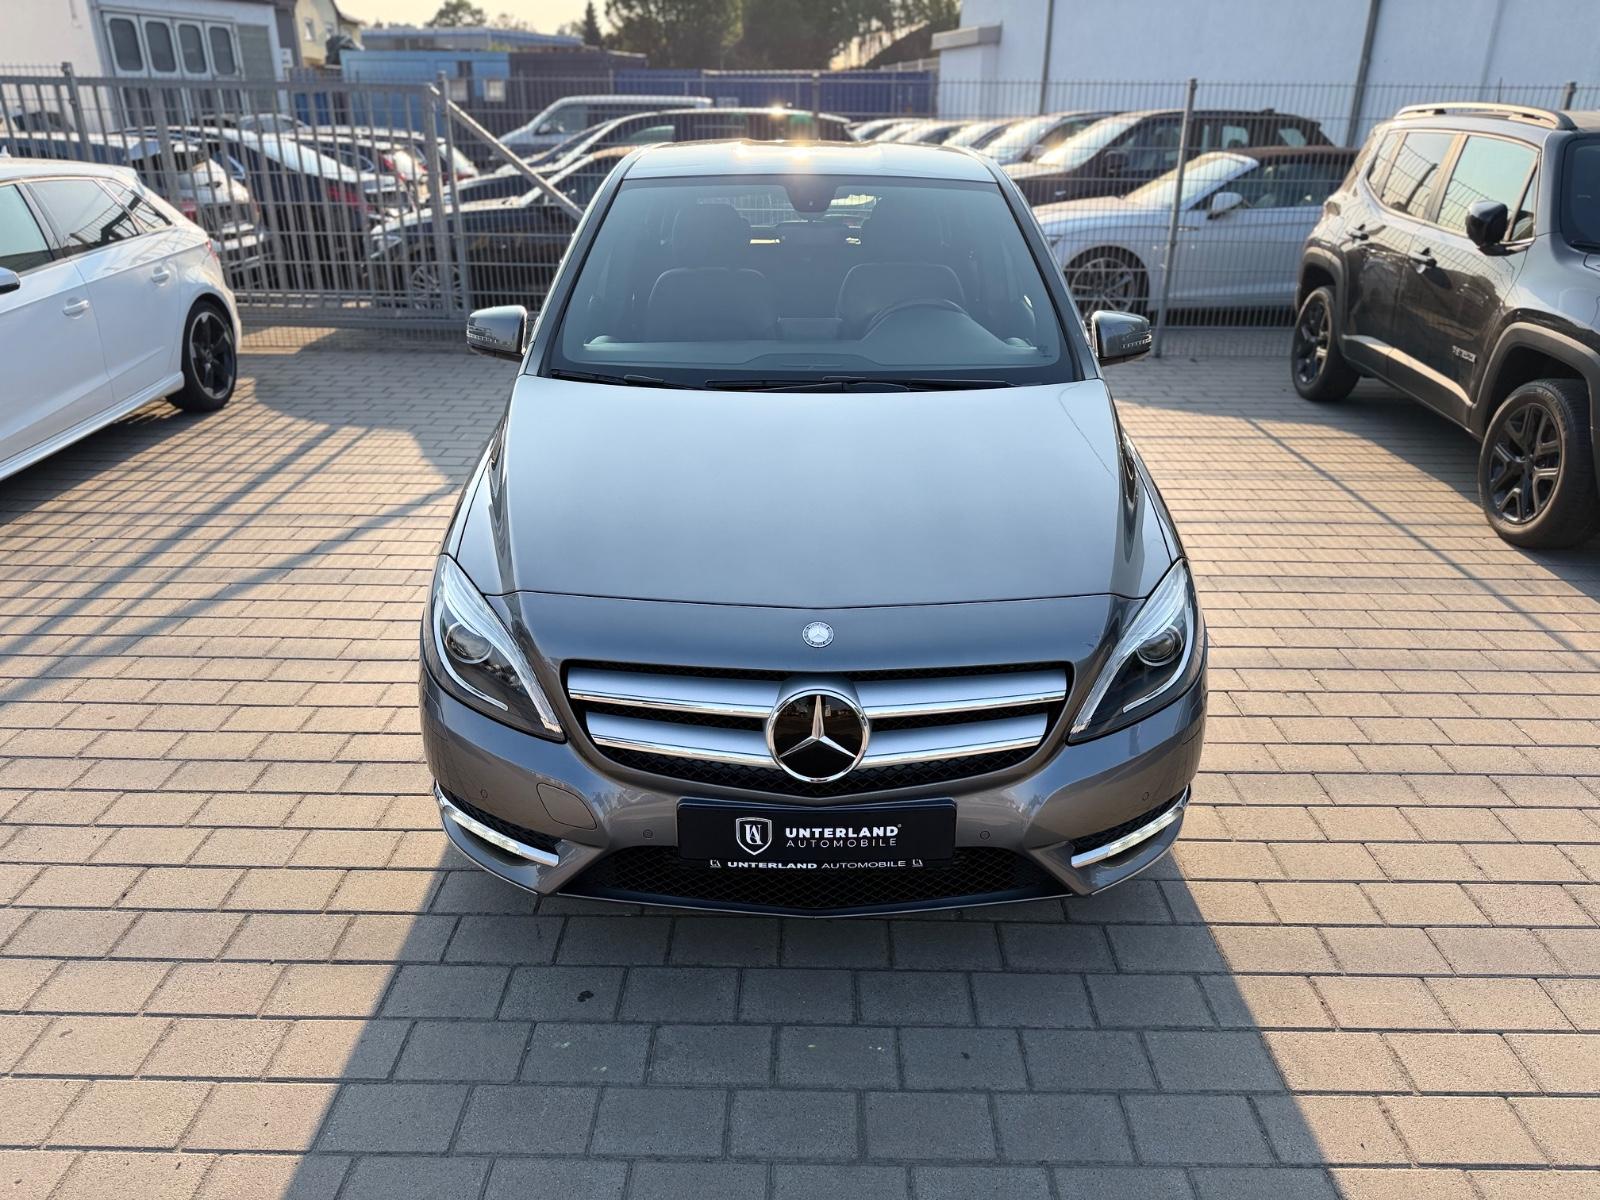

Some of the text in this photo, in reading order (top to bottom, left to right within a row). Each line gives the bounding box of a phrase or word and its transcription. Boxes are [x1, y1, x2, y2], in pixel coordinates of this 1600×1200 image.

[786, 838, 897, 848] AUTOMOBILE
[727, 861, 818, 869] UNTERLAND
[821, 860, 906, 869] AUTOMOBILE
